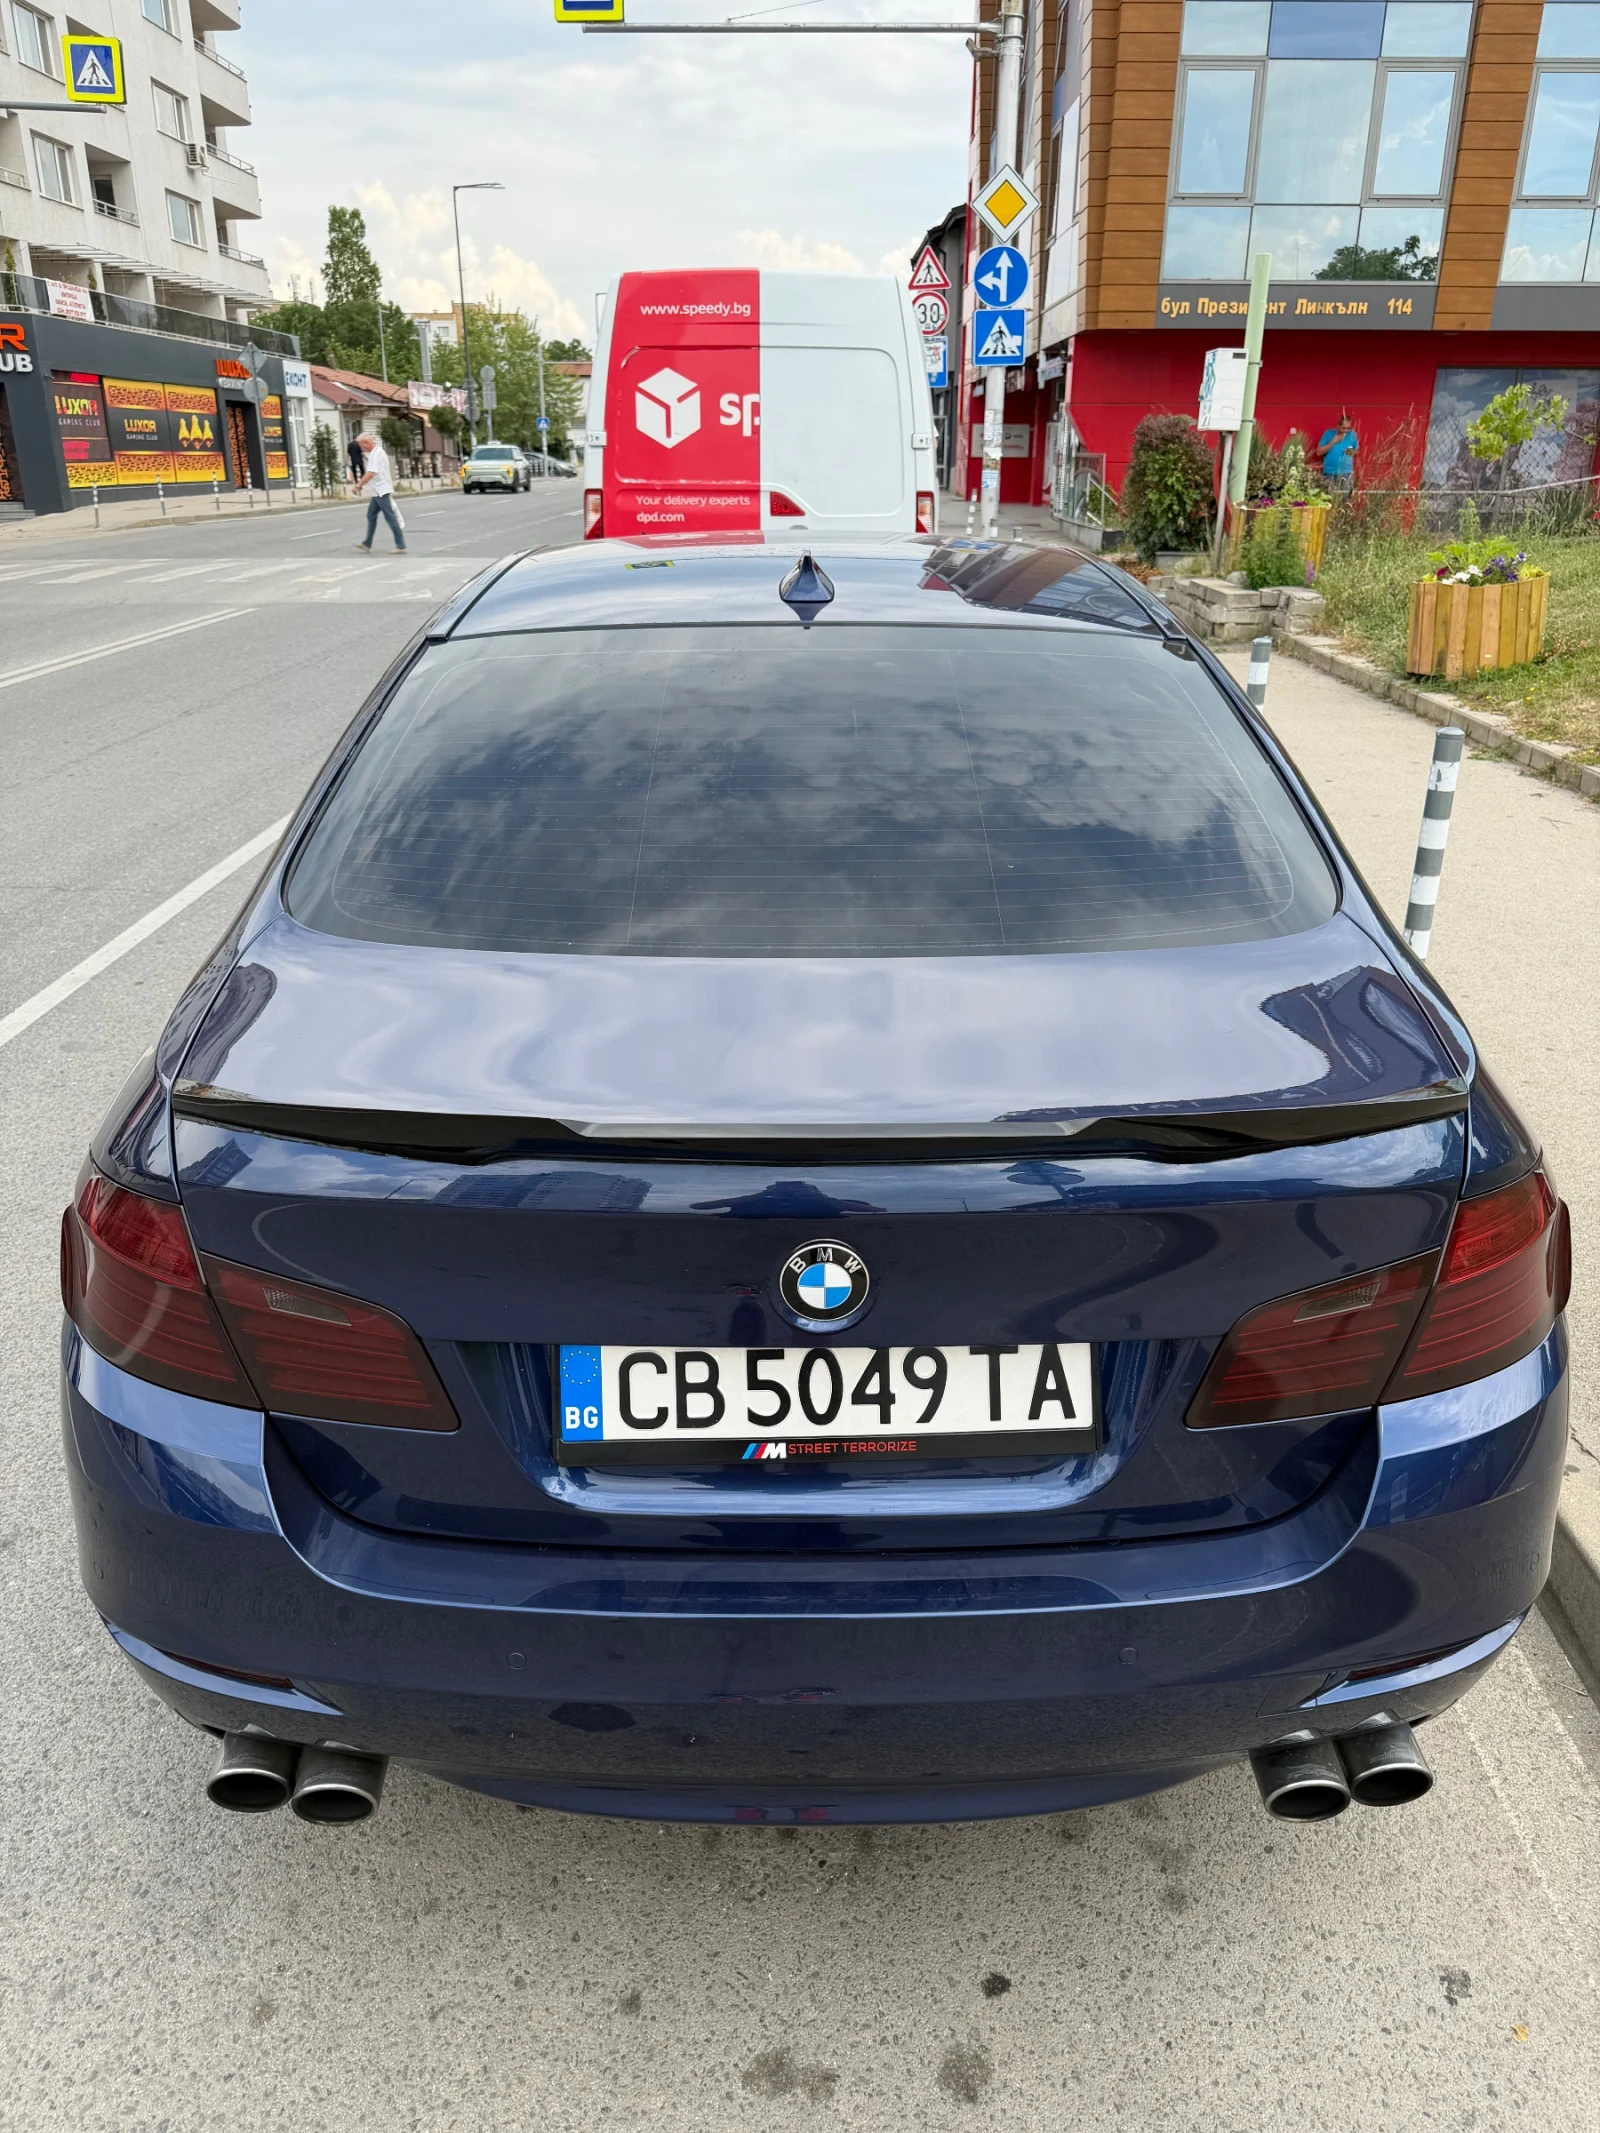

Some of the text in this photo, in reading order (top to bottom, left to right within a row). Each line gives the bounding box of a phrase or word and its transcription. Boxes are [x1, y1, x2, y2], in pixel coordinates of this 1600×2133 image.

[640, 302, 751, 317] www.speedy.bg
[918, 303, 940, 324] 30
[1160, 297, 1413, 318] бул Презинт Линкълн 114
[54, 395, 98, 417] LUXOR
[124, 418, 156, 433] LUXOR
[636, 496, 750, 508] Your delivery experts
[636, 511, 685, 522] dpd.com
[789, 1247, 862, 1274] BMW
[618, 1344, 1076, 1429] CB 5049 TA
[565, 1406, 599, 1431] BG
[788, 1443, 838, 1454] STREET
[842, 1441, 917, 1452] TERRORIZE
